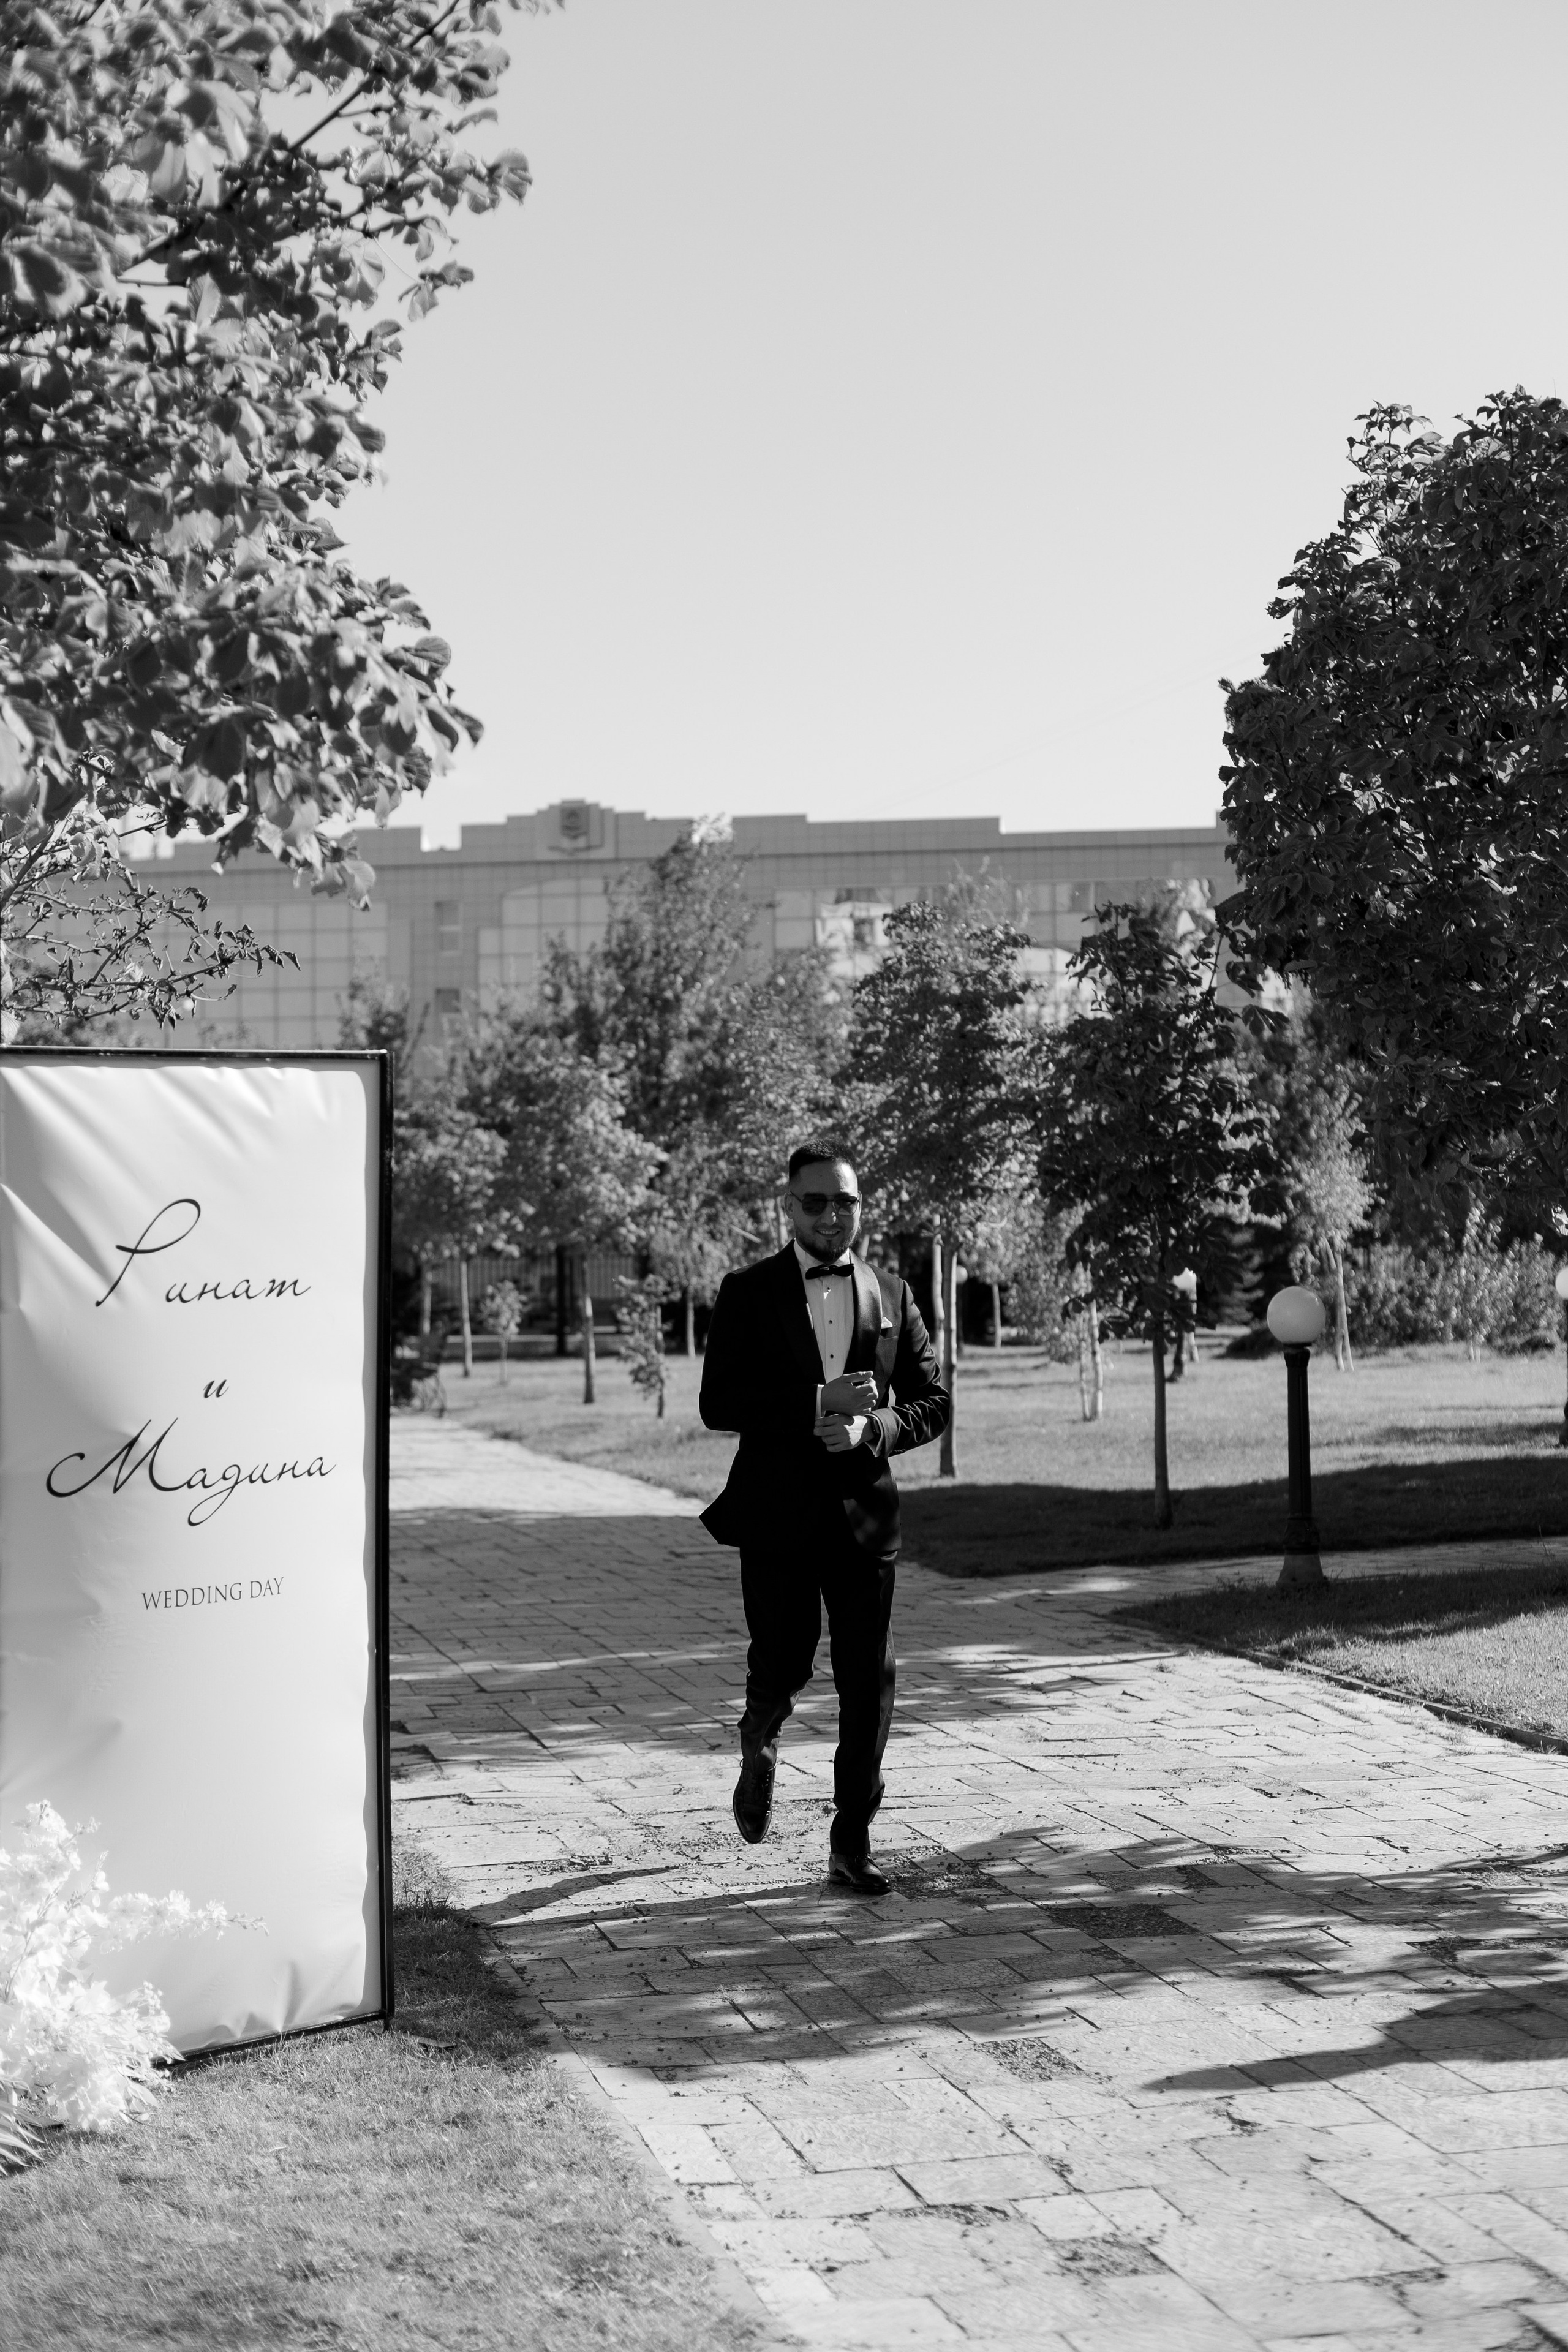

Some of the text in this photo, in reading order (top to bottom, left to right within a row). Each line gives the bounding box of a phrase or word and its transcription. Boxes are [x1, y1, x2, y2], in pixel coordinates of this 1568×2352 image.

[95, 1198, 311, 1308] Ринат
[203, 1379, 229, 1399] и
[45, 1417, 337, 1527] Мадина
[141, 1577, 284, 1611] WEDDING DAY
